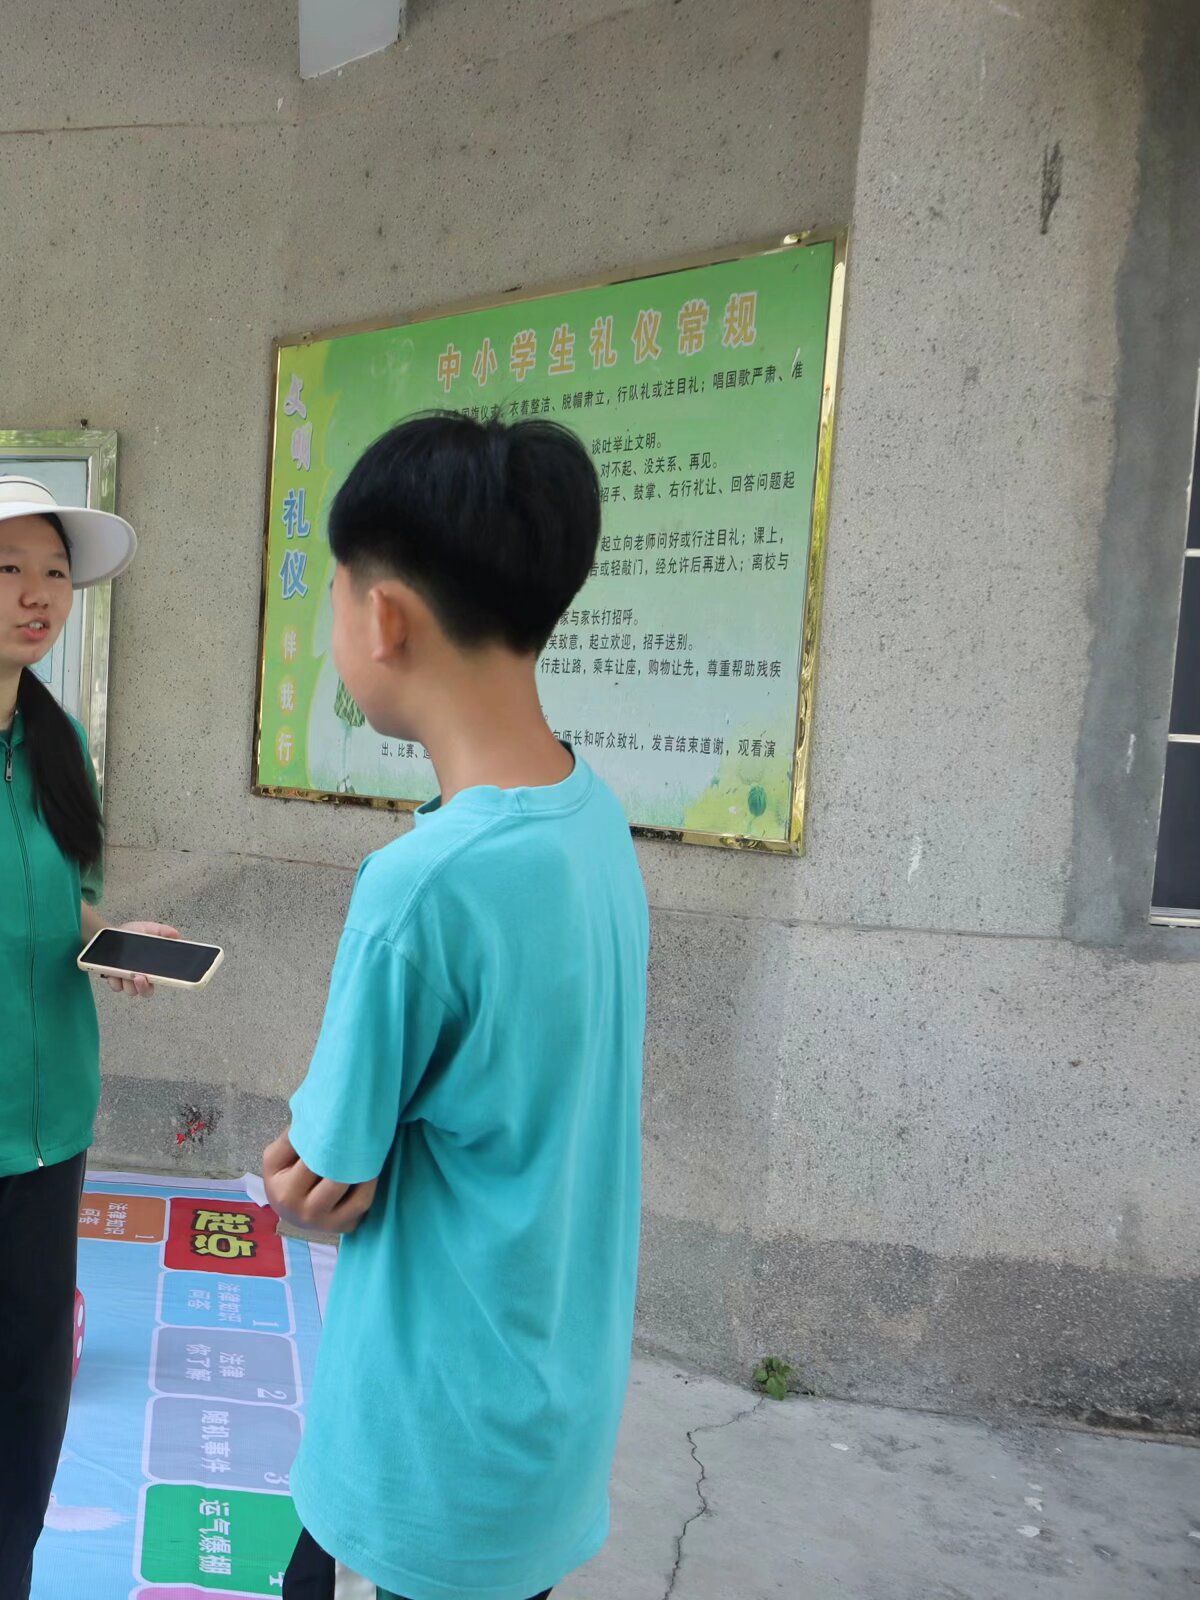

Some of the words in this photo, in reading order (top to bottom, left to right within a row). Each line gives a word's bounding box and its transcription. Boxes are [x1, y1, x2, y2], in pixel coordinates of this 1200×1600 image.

[437, 291, 758, 393] 中小学生礼仪常规
[194, 1209, 255, 1260] 起点
[184, 1343, 212, 1382] 你了解
[219, 1353, 246, 1380] 法律
[256, 1386, 288, 1401] 2
[201, 1409, 231, 1474] 随机事件
[199, 1498, 232, 1576] 运气爆棚
